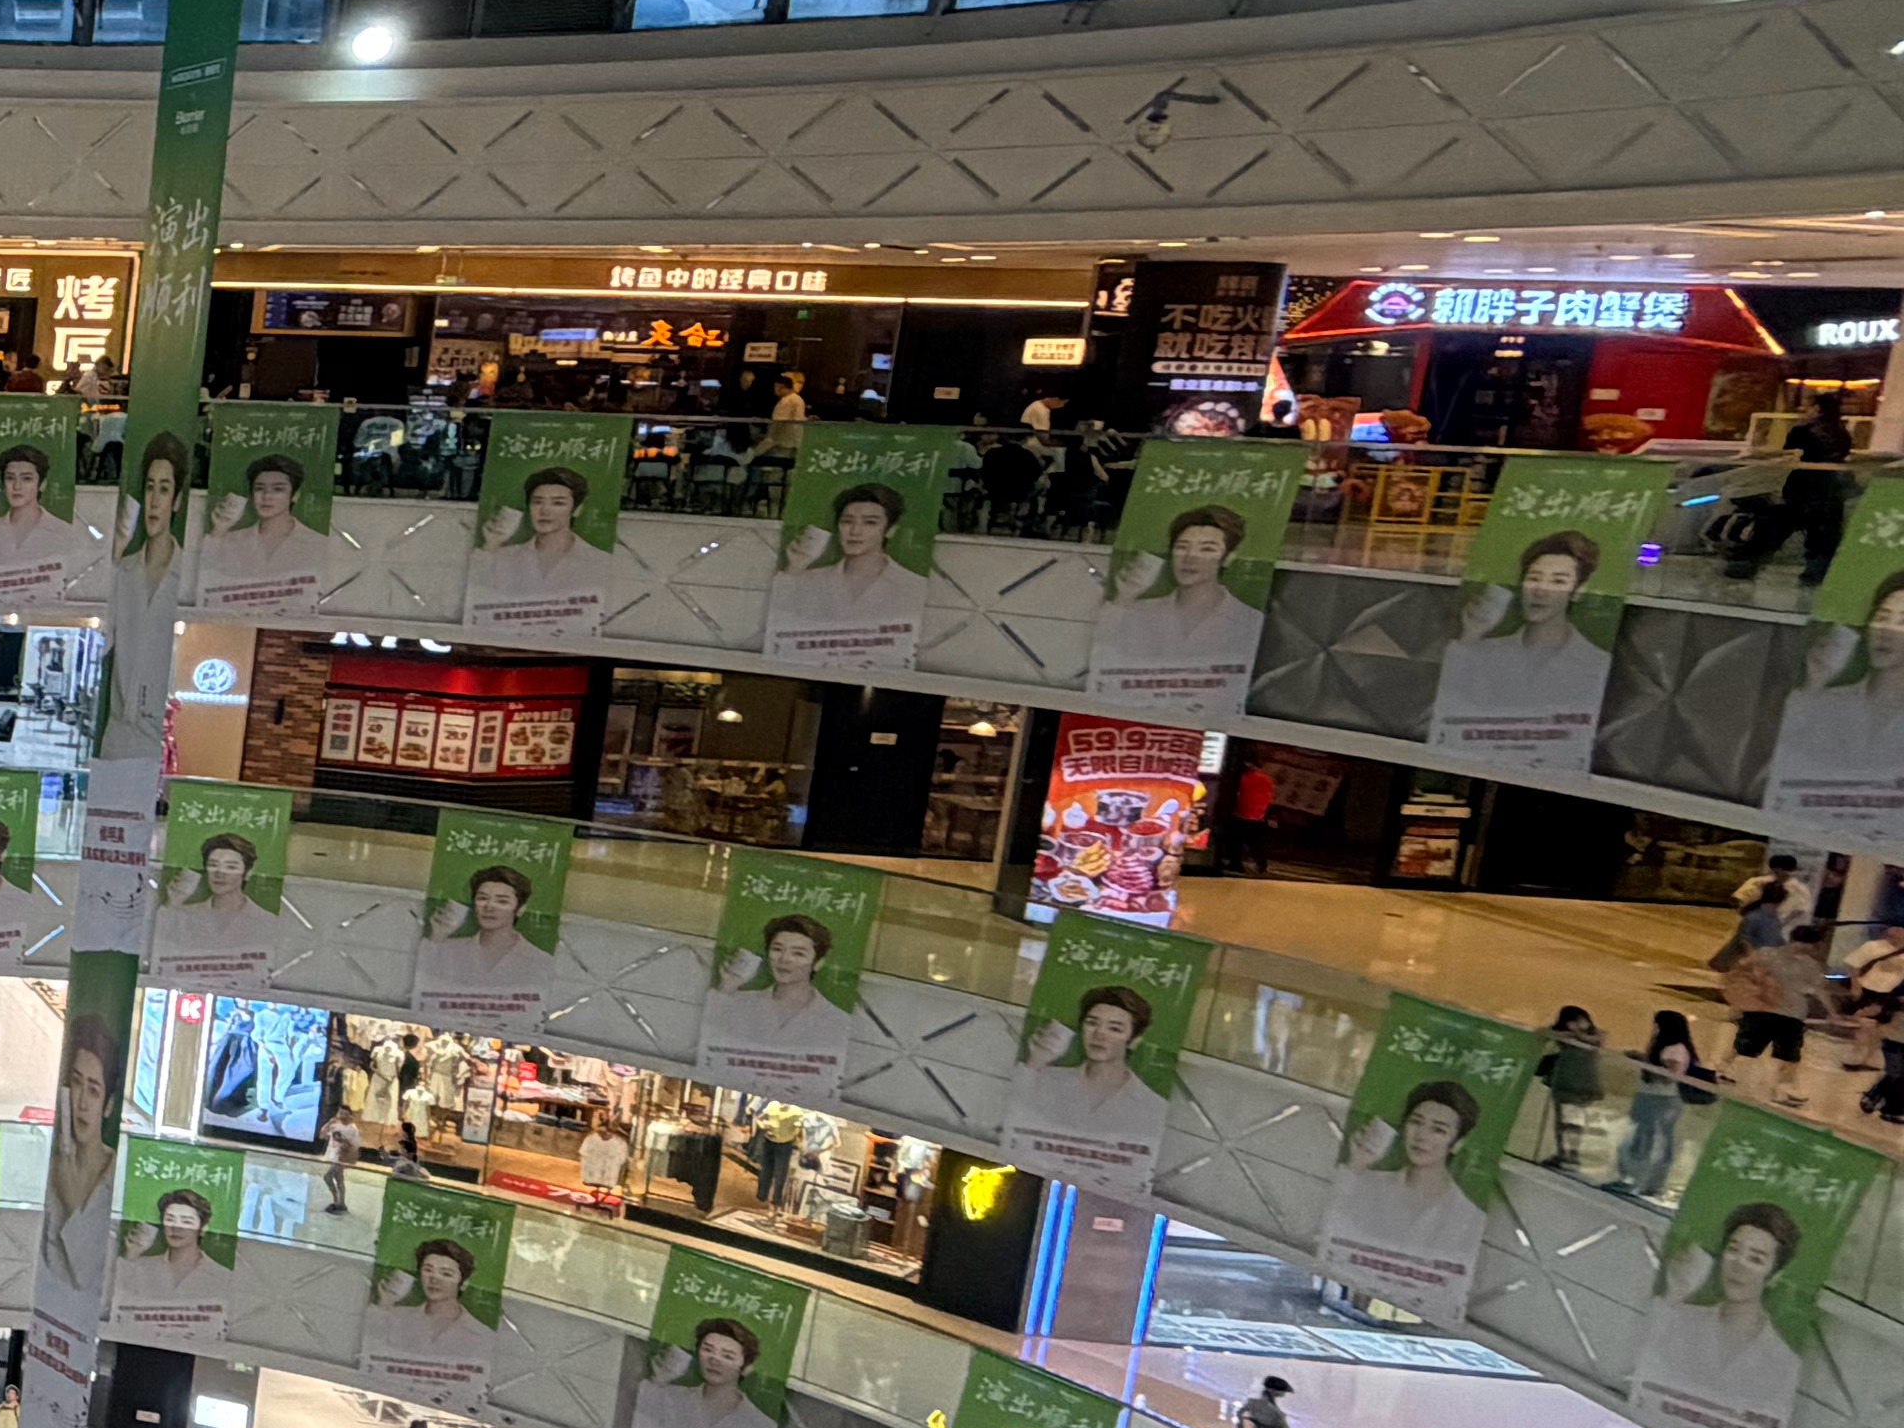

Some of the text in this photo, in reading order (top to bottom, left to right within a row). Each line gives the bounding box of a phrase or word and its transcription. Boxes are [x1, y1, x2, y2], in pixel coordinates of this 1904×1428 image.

[151, 197, 209, 257] 演出
[610, 265, 829, 293] 烤鱼中的经典口味
[53, 274, 122, 373] 烤匠
[140, 266, 206, 357] 顺利
[1817, 318, 1900, 346] ROUX
[498, 436, 616, 467] 演出顺利
